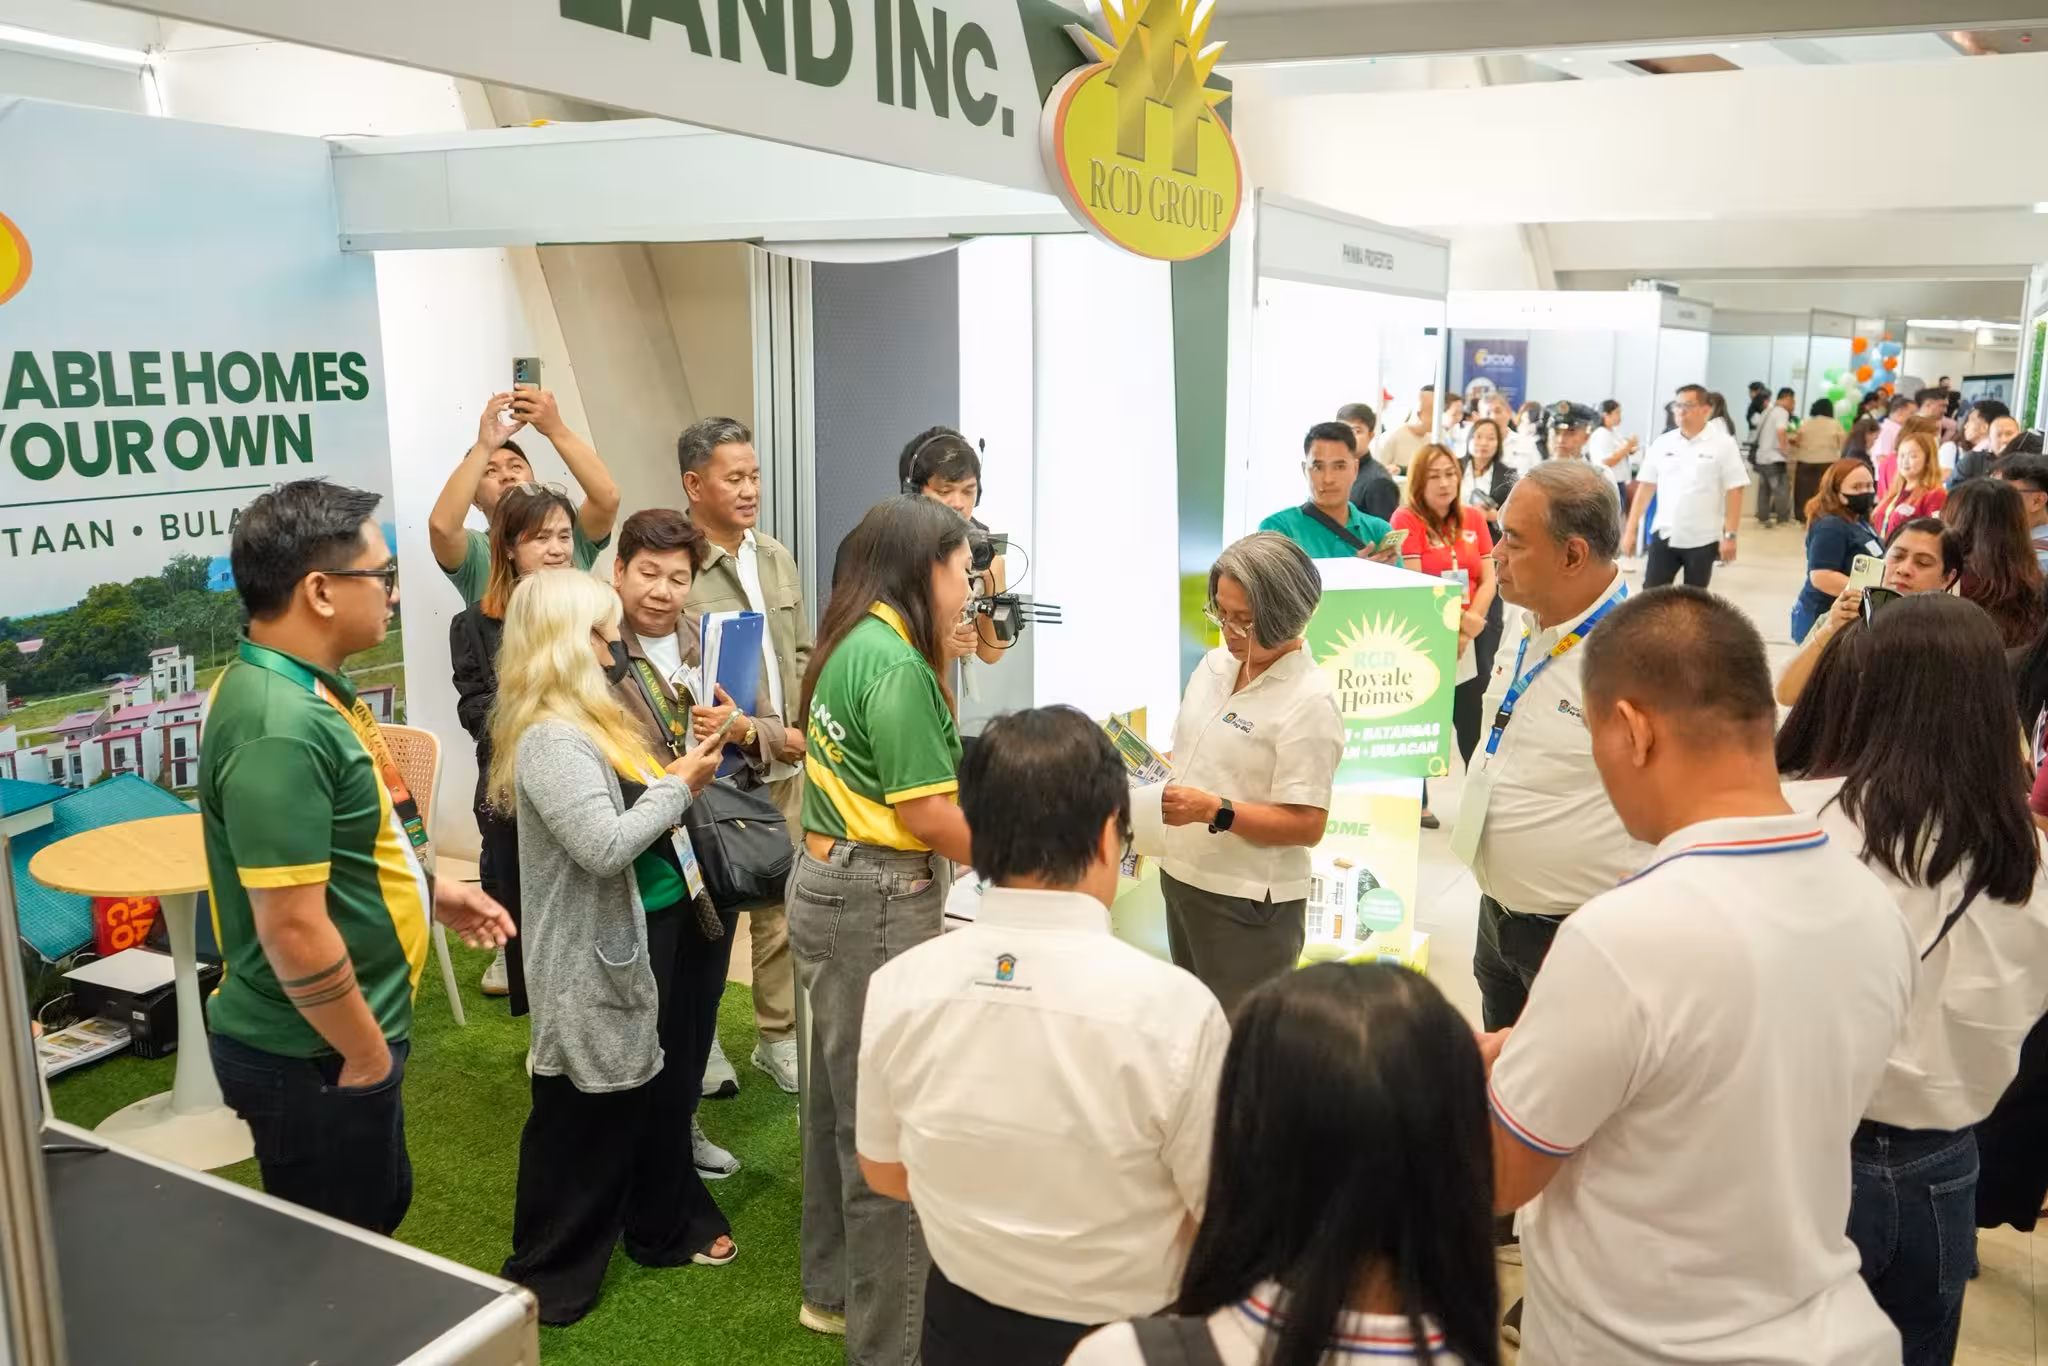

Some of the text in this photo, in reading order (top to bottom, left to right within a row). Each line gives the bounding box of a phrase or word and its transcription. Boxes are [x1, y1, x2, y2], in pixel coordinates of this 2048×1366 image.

[873, 0, 1014, 138] INC.
[1090, 158, 1224, 232] RCD GROUP
[172, 351, 370, 405] HOMES
[164, 414, 314, 471] OWN
[1, 519, 115, 557] TAAN
[1338, 667, 1412, 692] Royale
[1341, 690, 1414, 712] Homes
